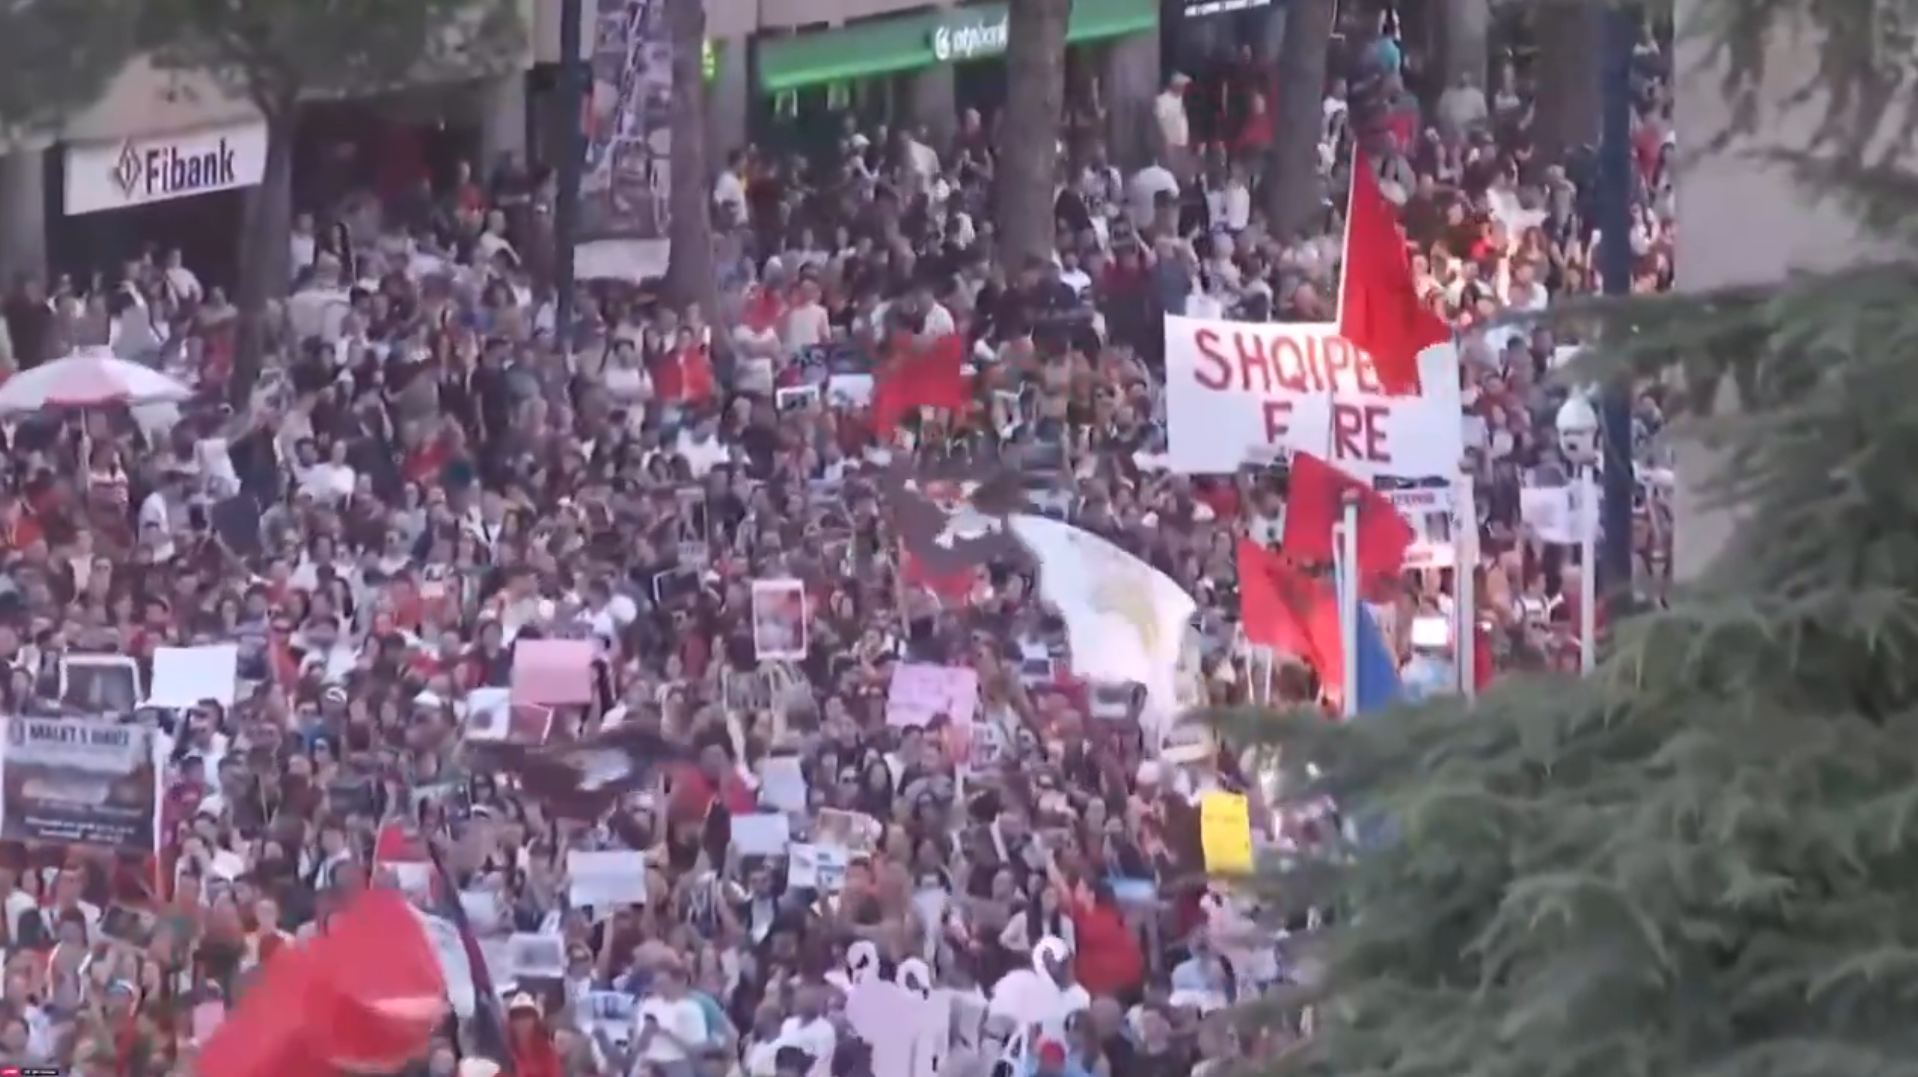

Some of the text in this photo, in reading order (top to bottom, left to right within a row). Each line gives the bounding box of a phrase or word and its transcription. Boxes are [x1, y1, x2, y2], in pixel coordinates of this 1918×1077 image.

[145, 136, 235, 194] Fibank
[1194, 328, 1381, 394] SHQIPE
[1333, 403, 1391, 463] RE
